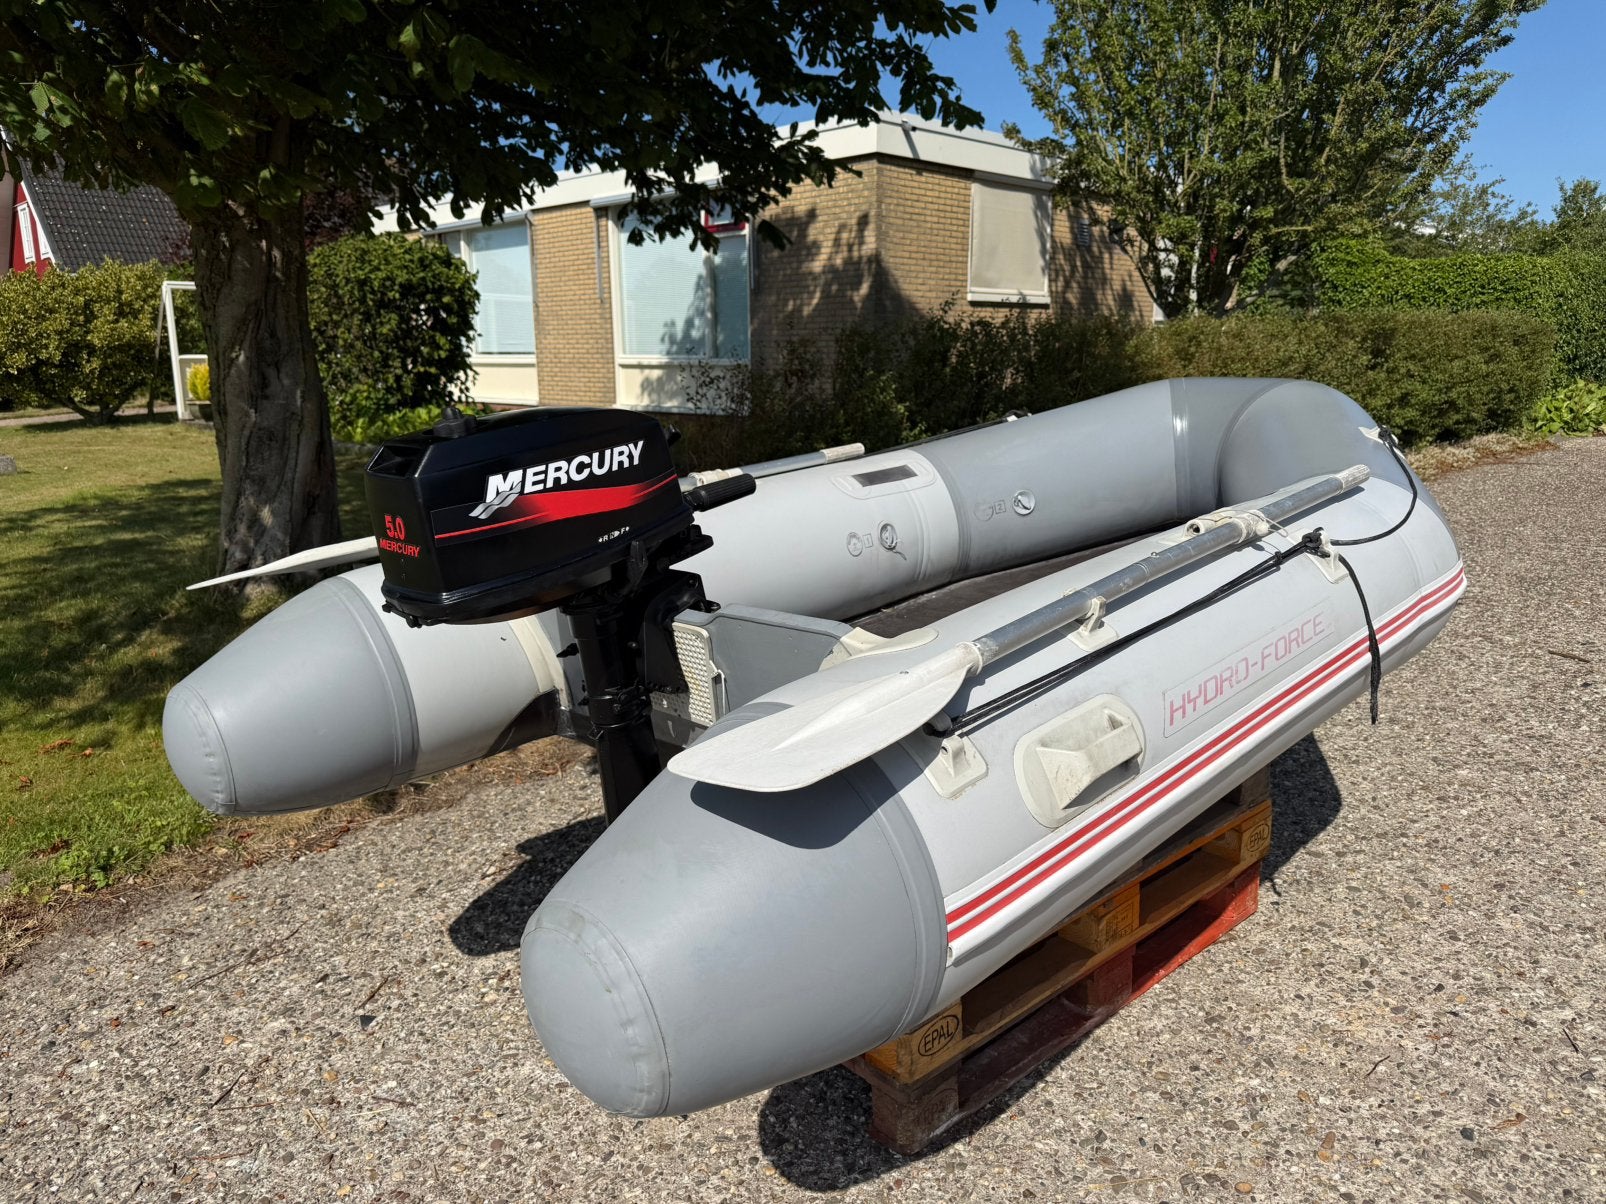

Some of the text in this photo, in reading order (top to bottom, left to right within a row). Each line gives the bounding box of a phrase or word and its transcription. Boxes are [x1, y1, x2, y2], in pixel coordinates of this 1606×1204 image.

[485, 440, 644, 503] MERCURY
[385, 515, 405, 540] 5.0
[380, 538, 420, 557] MERCURY
[1169, 611, 1326, 727] HYDRO-FORCE
[924, 1020, 953, 1053] EPAL
